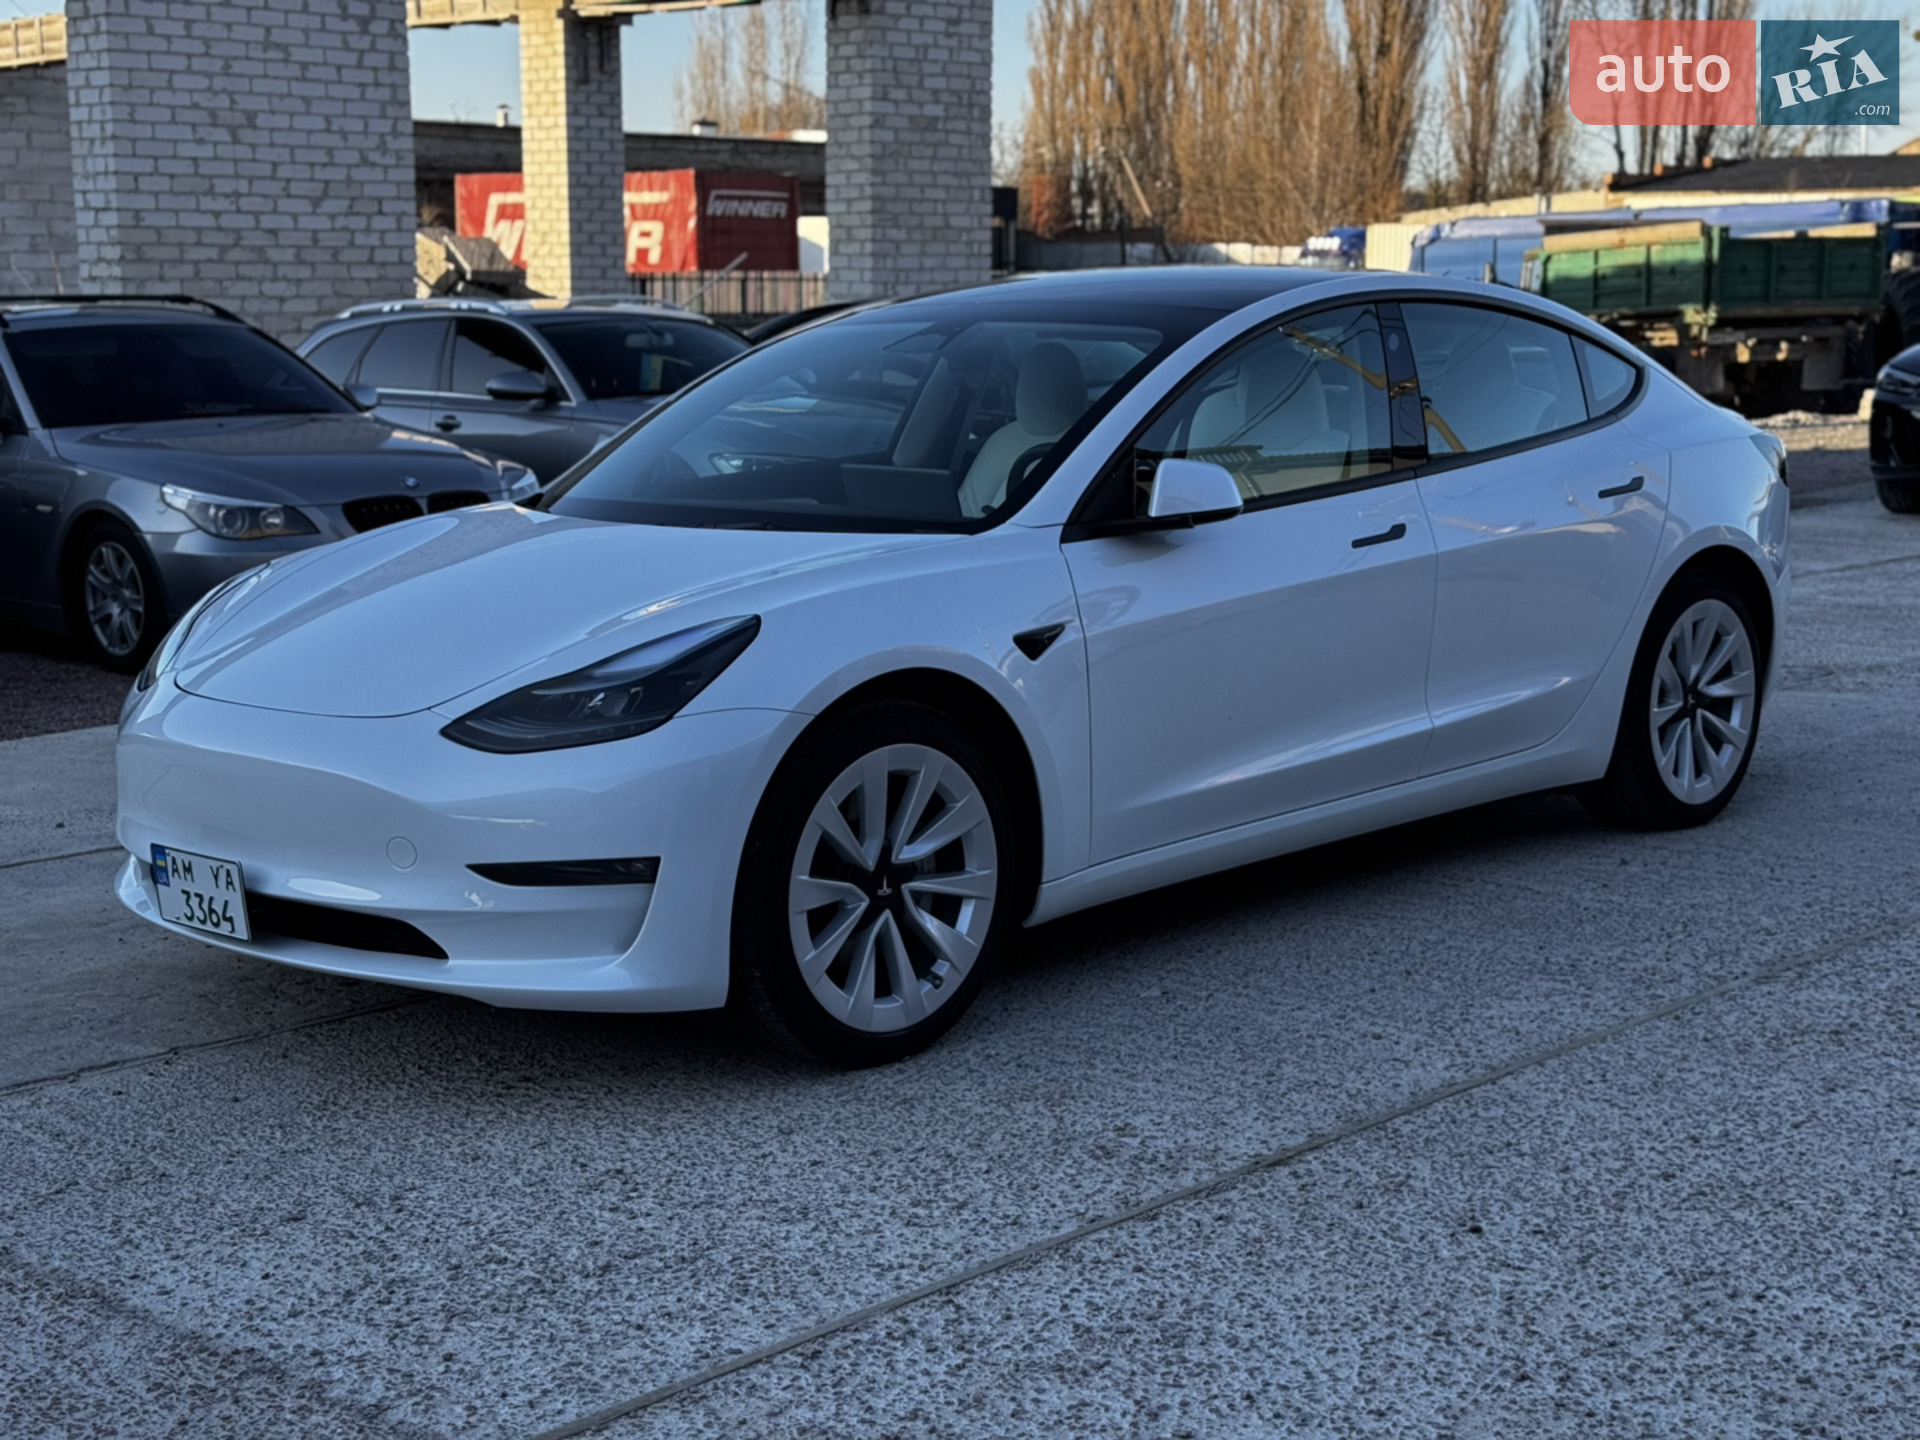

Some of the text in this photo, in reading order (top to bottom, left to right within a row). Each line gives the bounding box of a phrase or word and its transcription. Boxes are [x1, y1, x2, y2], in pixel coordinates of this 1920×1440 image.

[706, 195, 788, 218] WINNER
[171, 856, 237, 893] AM YA
[181, 889, 236, 933] 3364
